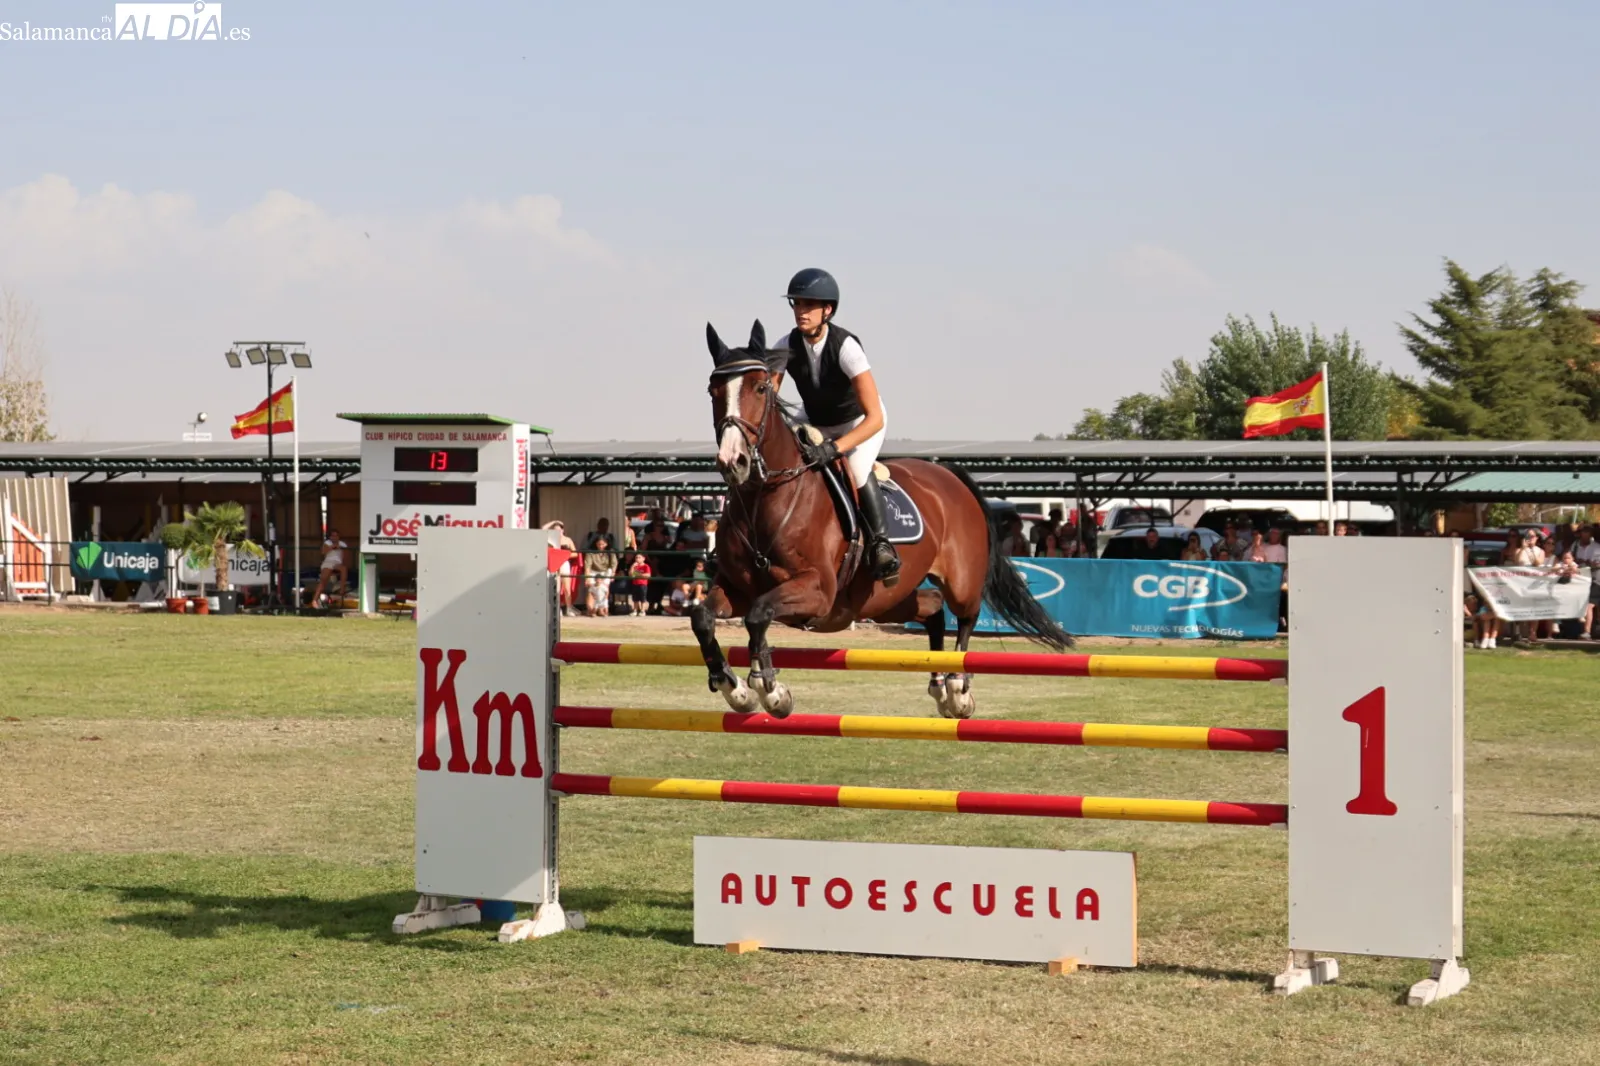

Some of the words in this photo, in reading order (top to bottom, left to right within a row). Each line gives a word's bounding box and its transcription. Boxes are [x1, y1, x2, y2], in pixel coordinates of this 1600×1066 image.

[365, 432, 384, 441] CLUB
[417, 432, 445, 441] CIUDAD
[449, 432, 458, 441] DE
[462, 432, 507, 441] SALAMANCA
[430, 451, 448, 471] 13
[368, 513, 422, 537] José
[103, 551, 159, 574] Unicaja
[228, 557, 270, 576] nicaja
[1133, 574, 1209, 599] CGB
[1131, 624, 1171, 633] NUEVAS
[1173, 625, 1244, 638] TECNOLOGÍAS
[418, 648, 543, 778] Km
[1342, 686, 1398, 816] 1
[721, 872, 1099, 921] AUTOESCUELA
